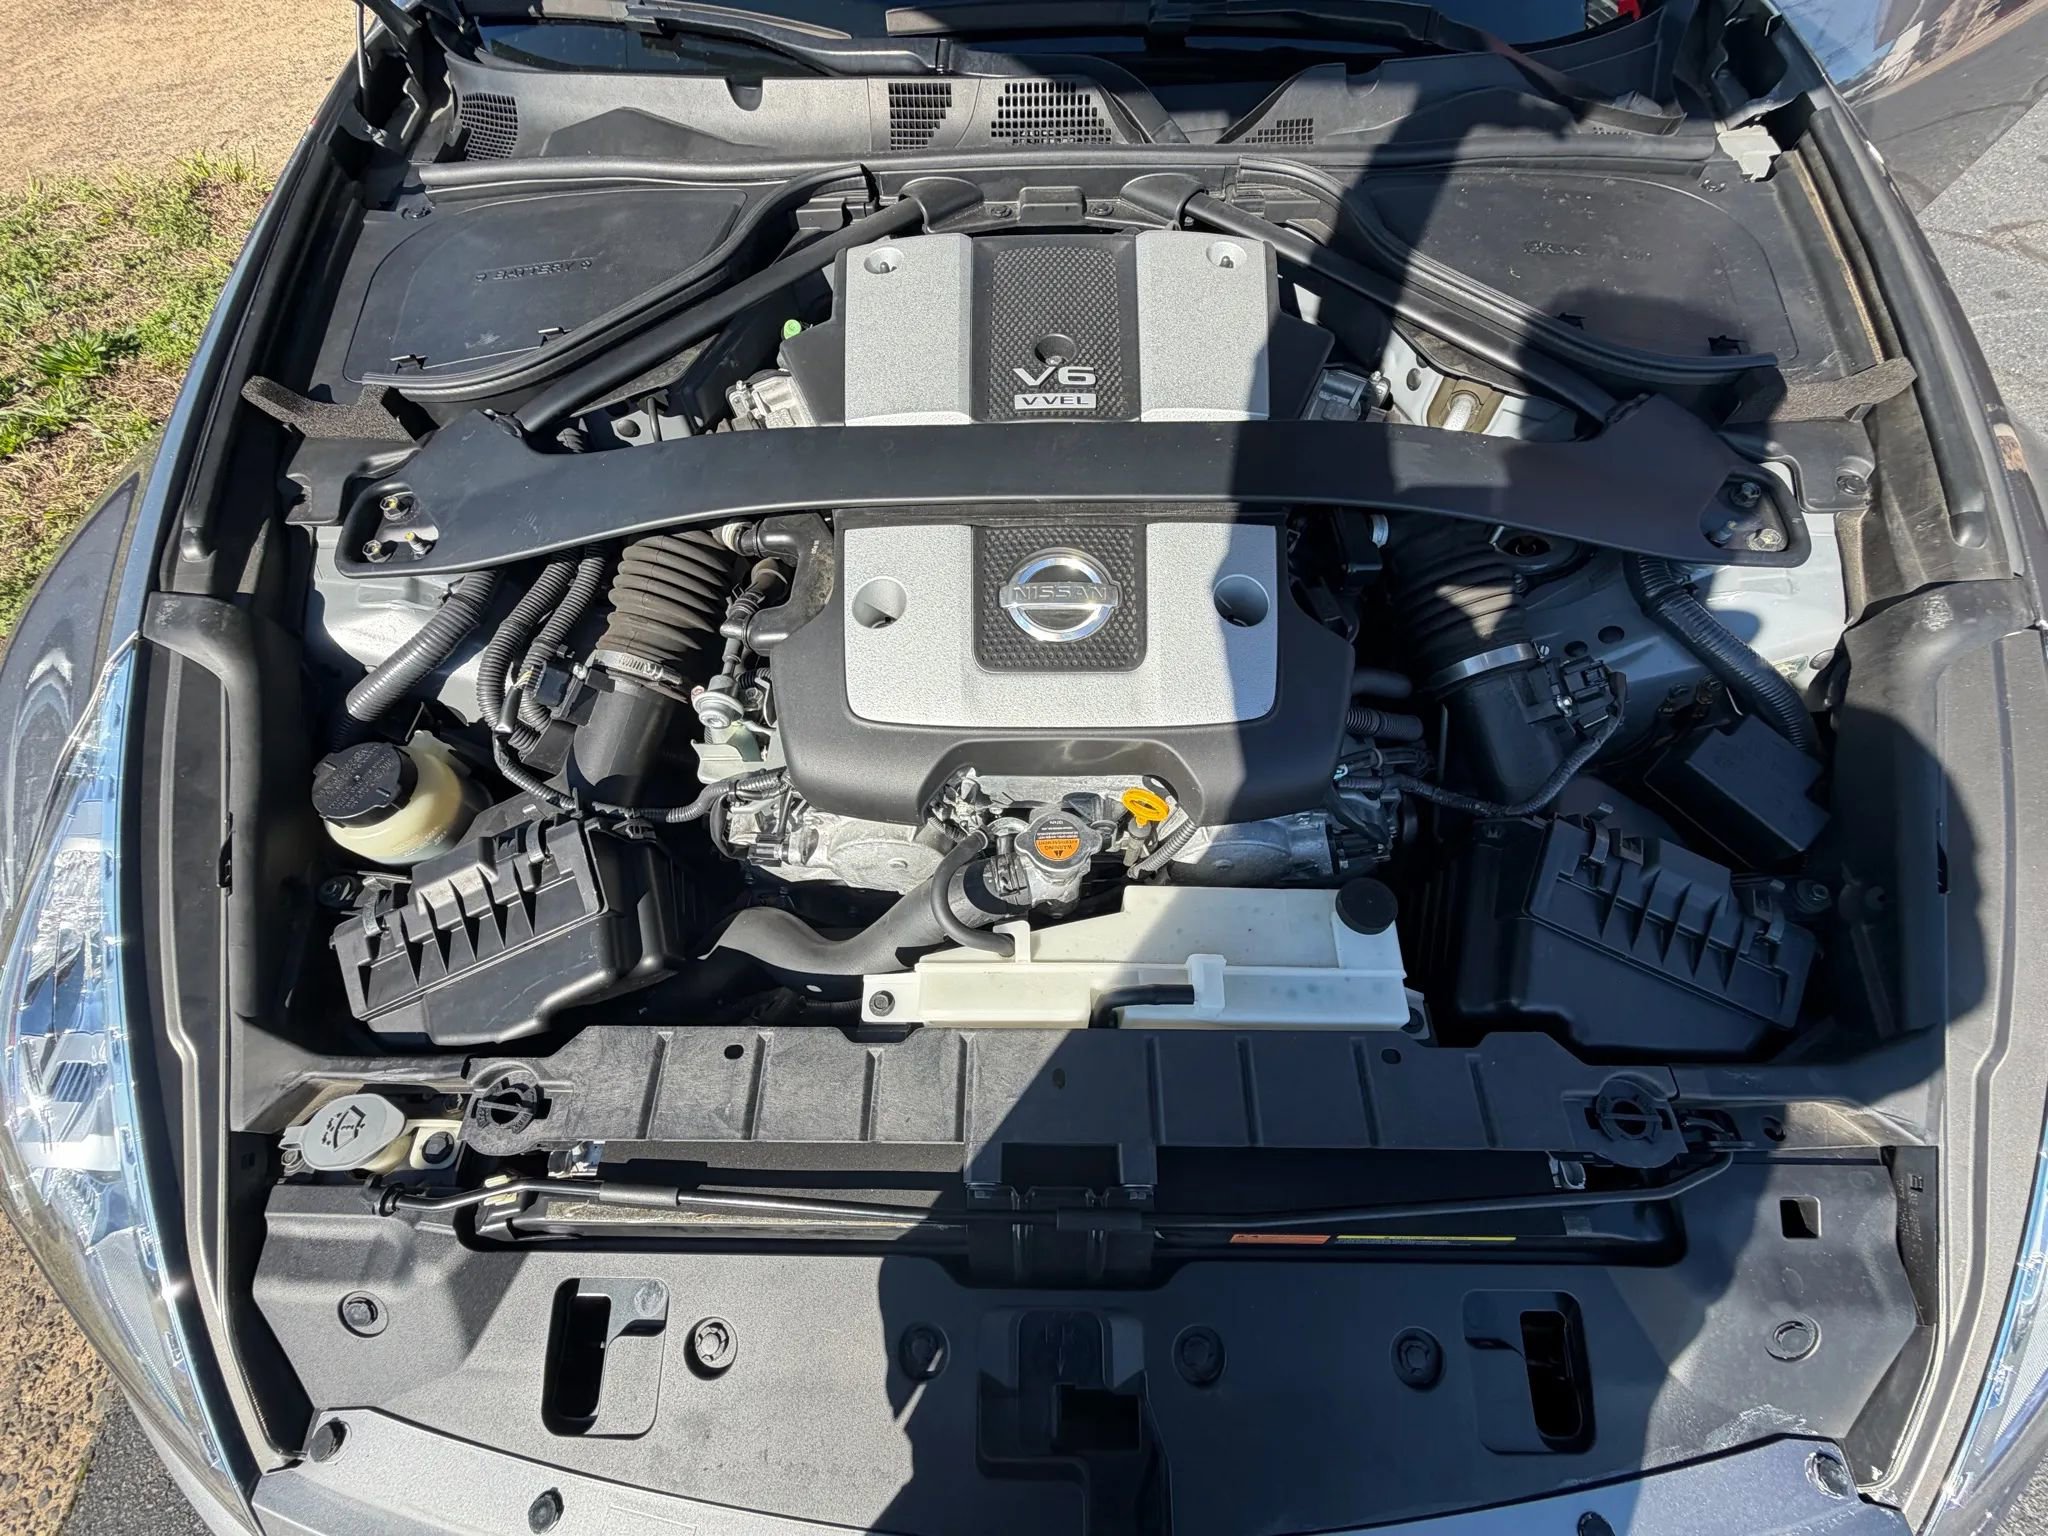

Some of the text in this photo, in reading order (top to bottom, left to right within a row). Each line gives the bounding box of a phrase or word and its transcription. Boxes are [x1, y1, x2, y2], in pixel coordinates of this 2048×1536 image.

[492, 261, 575, 281] BATTERY
[1012, 366, 1096, 386] V6
[1022, 396, 1089, 406] VVEL
[1013, 585, 1107, 601] NISSAN
